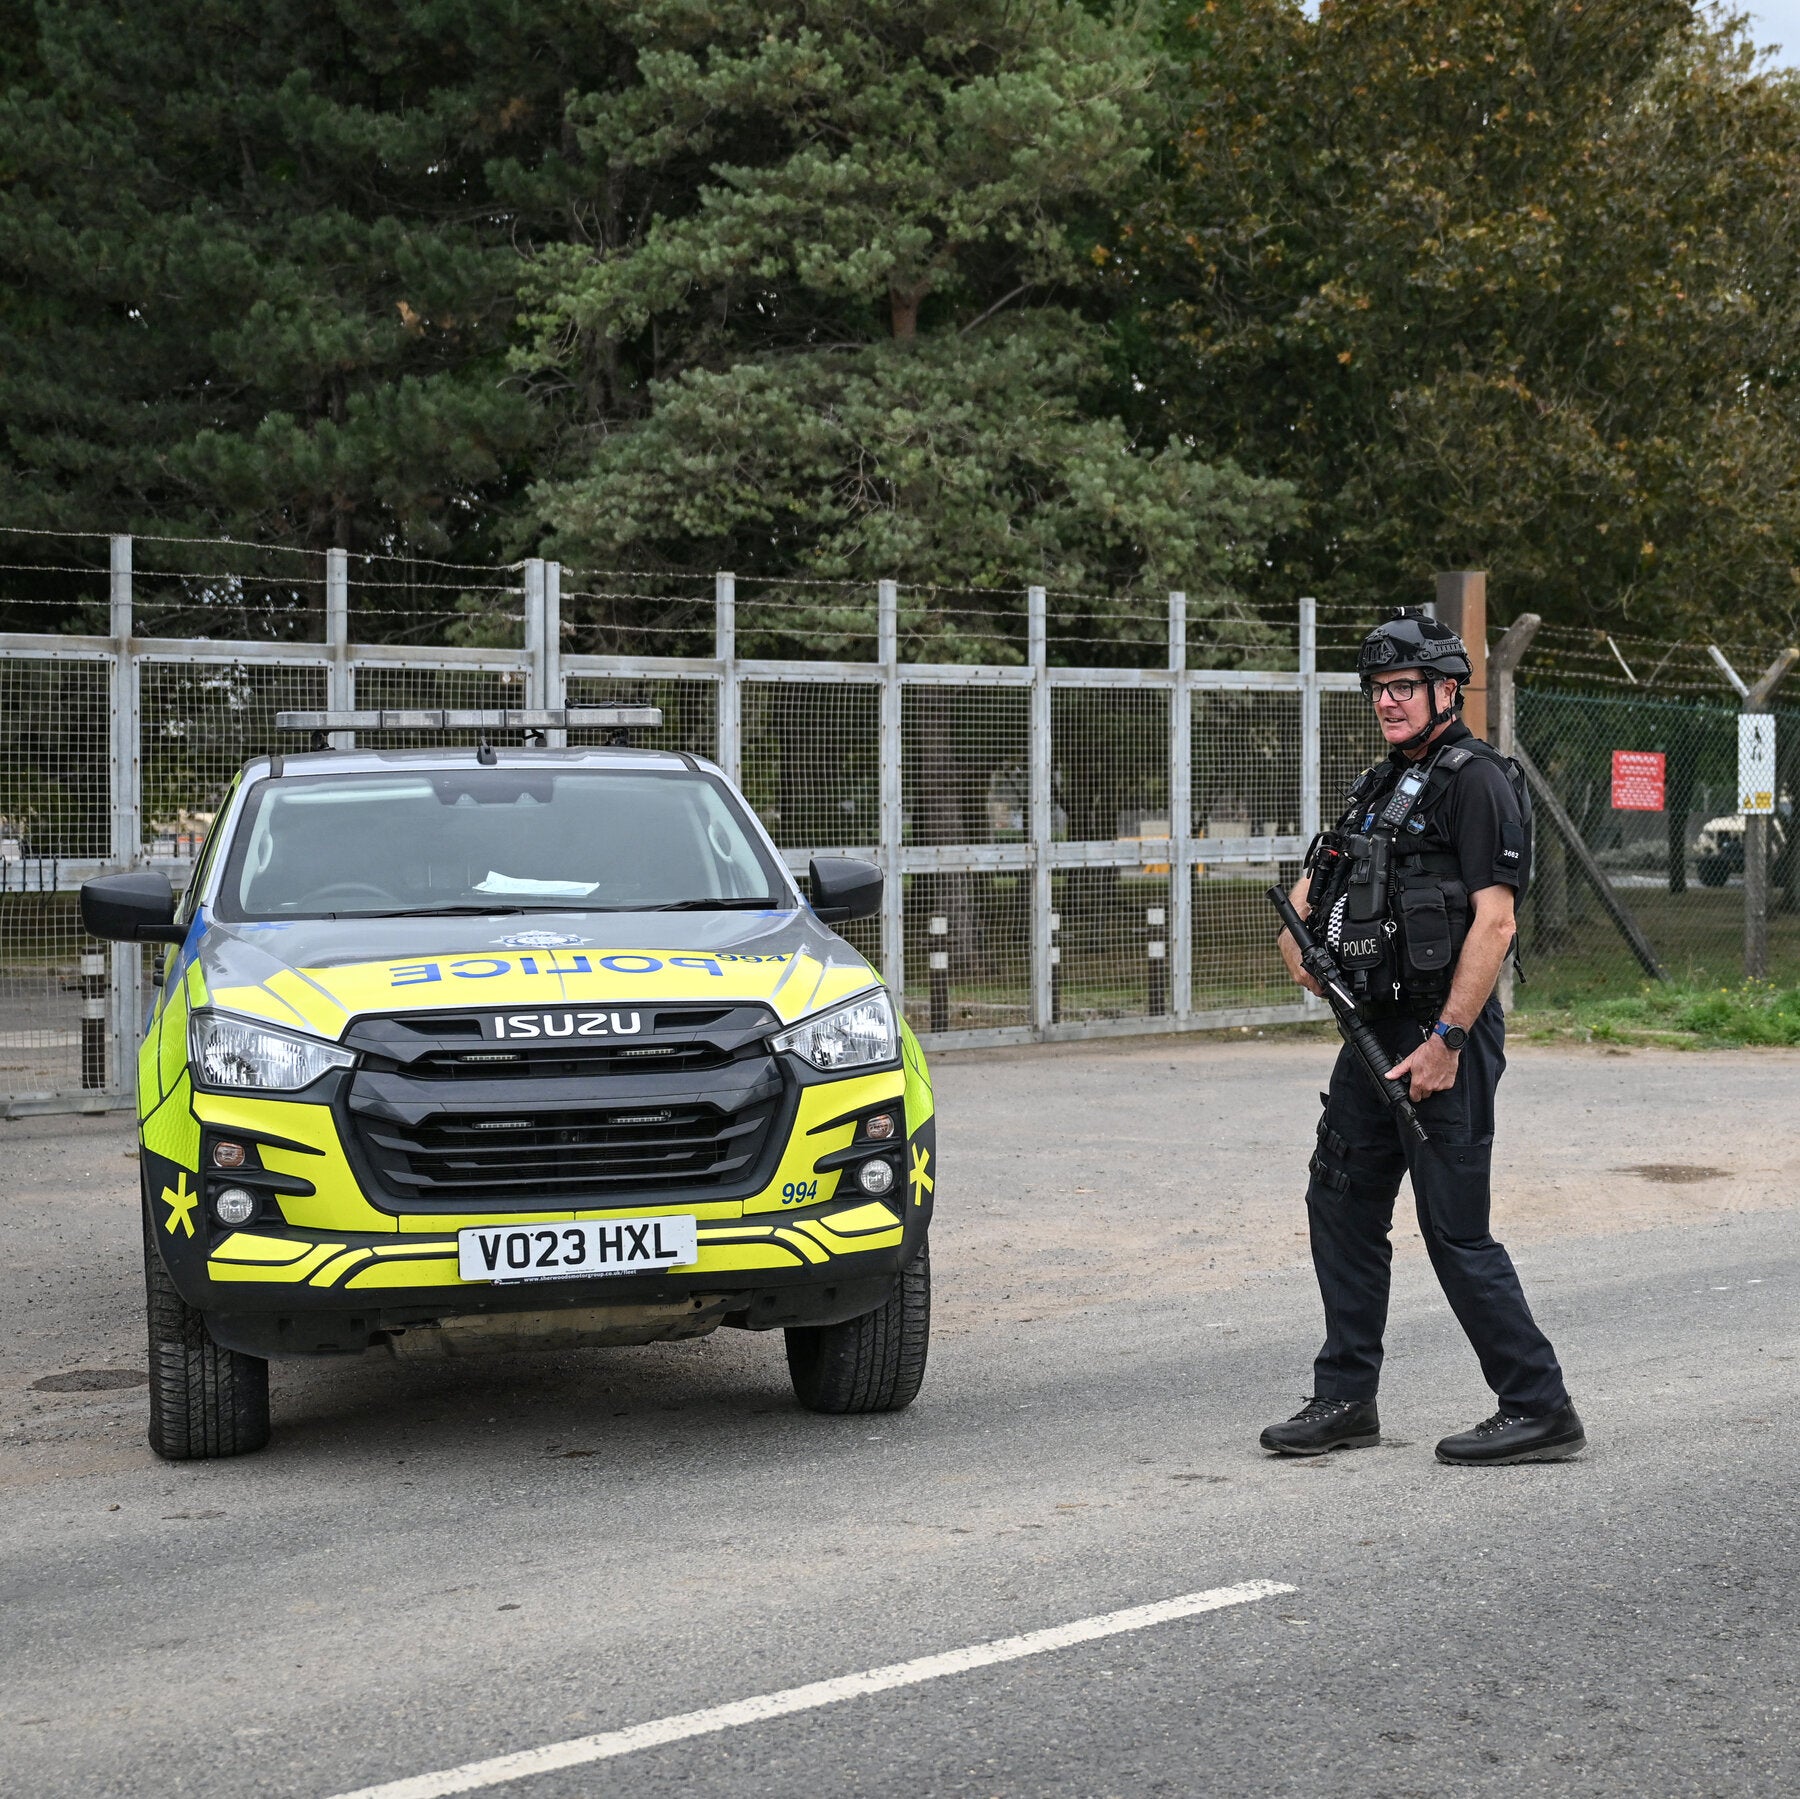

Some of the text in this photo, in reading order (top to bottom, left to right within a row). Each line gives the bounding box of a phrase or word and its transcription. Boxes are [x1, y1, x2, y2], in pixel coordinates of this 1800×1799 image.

[714, 953, 788, 963] 994
[1343, 938, 1378, 957] POLICE
[494, 1011, 642, 1039] ISUZU
[781, 1180, 818, 1205] 994
[599, 1223, 678, 1263] HXL
